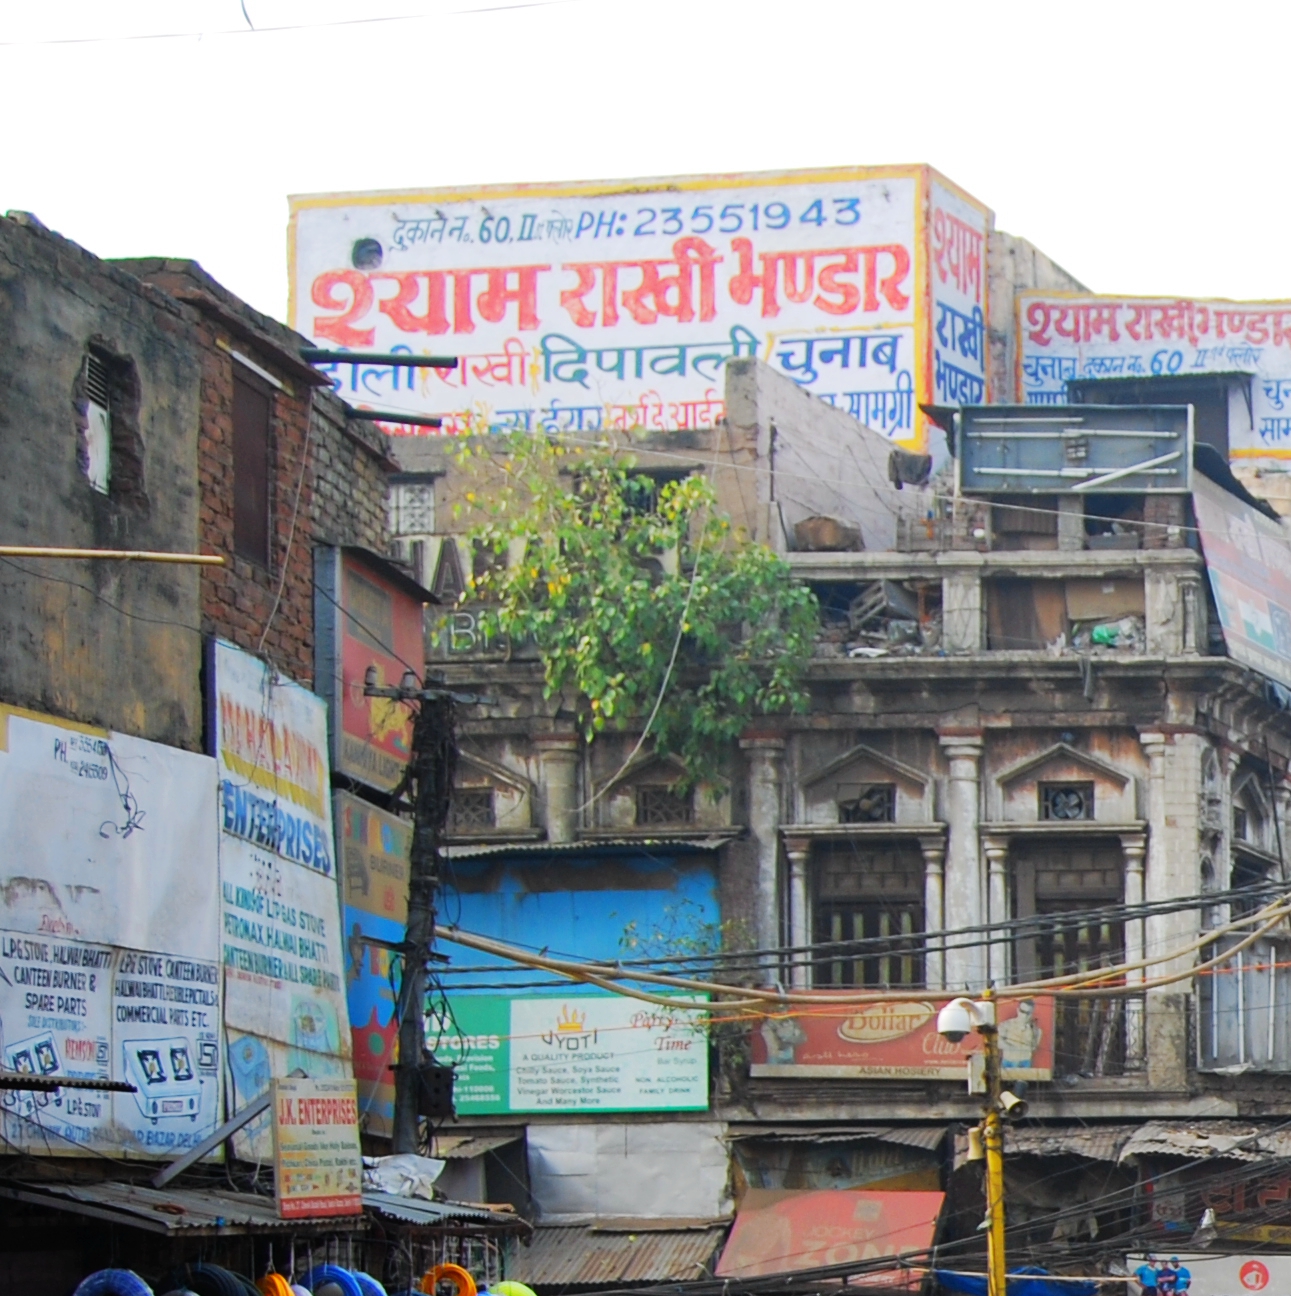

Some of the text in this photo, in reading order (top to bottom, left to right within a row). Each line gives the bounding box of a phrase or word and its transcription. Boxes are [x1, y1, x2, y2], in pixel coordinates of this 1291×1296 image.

[575, 210, 628, 239] PH:
[634, 197, 862, 238] 23551943
[932, 205, 984, 304] श्याम
[310, 236, 913, 347] श्याम राखी भण्डार
[935, 299, 986, 373] राखी
[1026, 300, 1124, 347] श्याम
[1124, 300, 1193, 345] राखी
[434, 336, 532, 387] राखी
[540, 324, 762, 390] दिपावली
[1150, 349, 1184, 376] 60
[222, 777, 332, 877] ENTERPRISES
[14, 965, 53, 988] CANTEEN
[53, 968, 87, 991] BURNER
[25, 992, 88, 1017] SPARE PARTS
[116, 1004, 168, 1025] COMMERCIAL
[848, 1001, 922, 1032] Dollar
[426, 1034, 500, 1051] STORES
[541, 1028, 598, 1051] JYOTI
[653, 1035, 693, 1052] Time
[530, 1053, 569, 1062] QUALITY
[572, 1052, 615, 1061] PRODUCT
[595, 1064, 621, 1074] Sauce
[858, 1065, 942, 1077] ASIAN HOSIERY
[596, 1085, 622, 1095] Sauce
[298, 1097, 358, 1126] ENTERPRISES
[809, 1225, 878, 1240] JOCKEY
